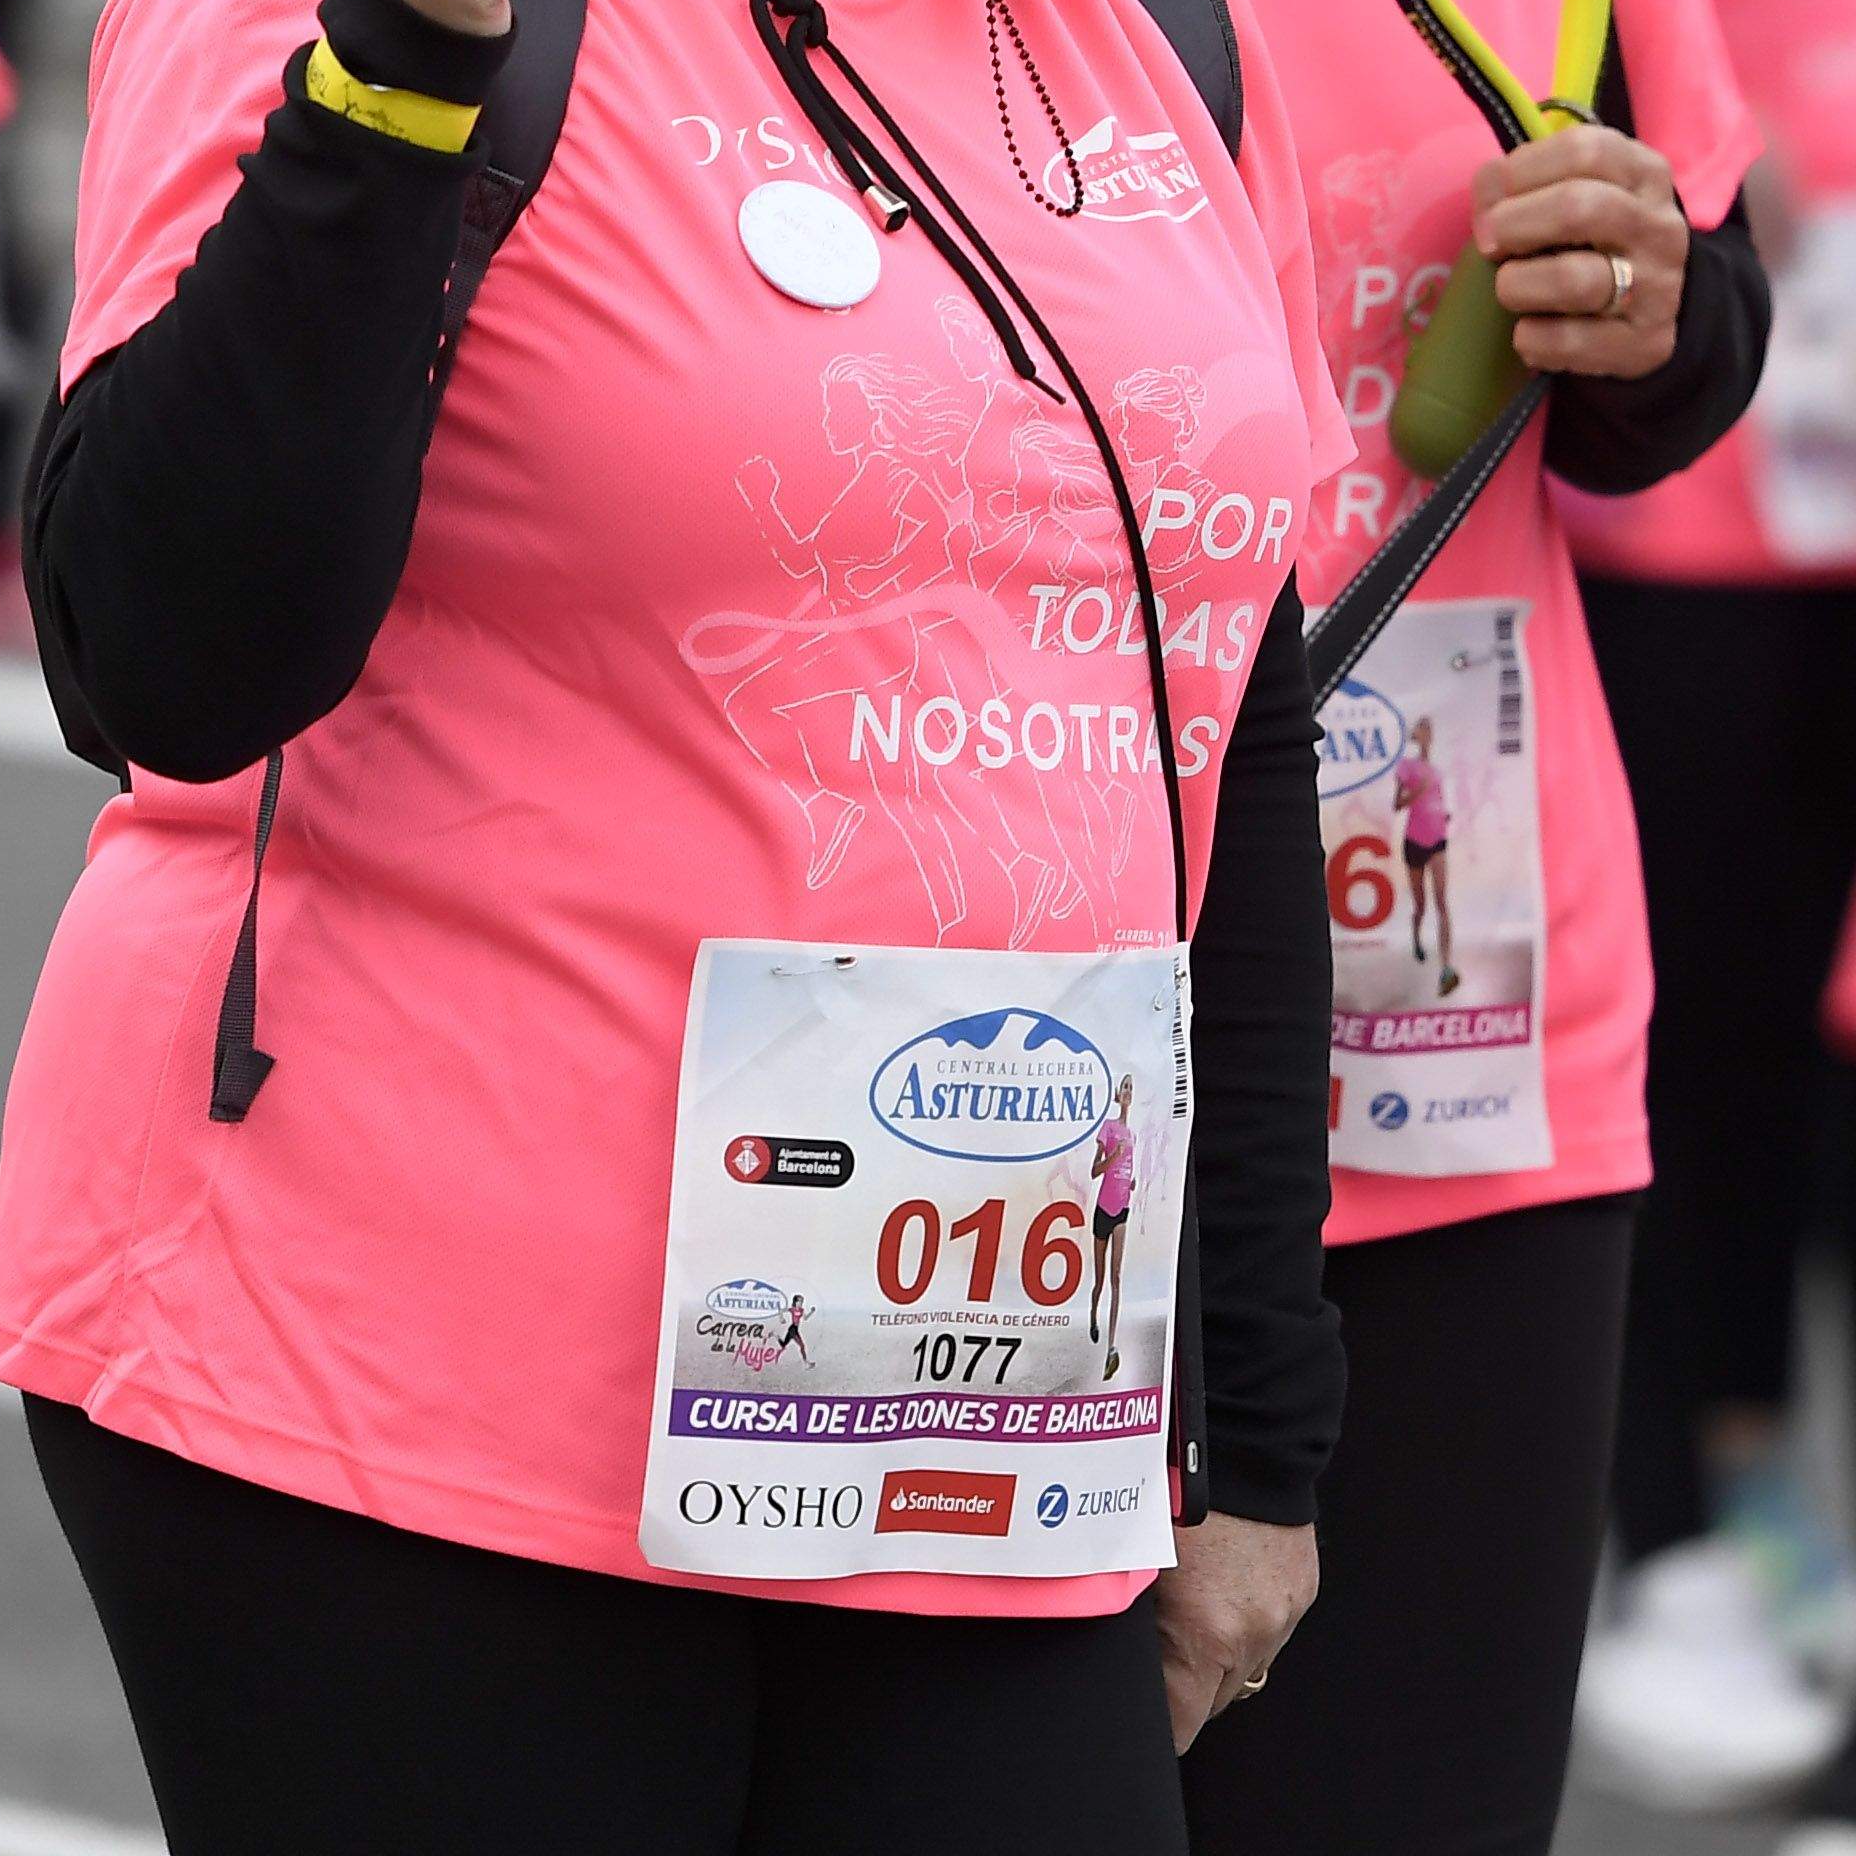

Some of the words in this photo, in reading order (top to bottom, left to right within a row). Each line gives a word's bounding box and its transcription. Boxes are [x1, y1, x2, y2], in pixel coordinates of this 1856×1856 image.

[1142, 487, 1294, 565] POR
[936, 1059, 1019, 1077] CENTRAL
[1026, 1060, 1095, 1077] LECHERA
[888, 1062, 1096, 1122] ASTURIANA
[777, 1159, 841, 1176] Barcelona
[876, 1197, 1088, 1307] 016
[696, 1314, 764, 1339] Carrera
[871, 1311, 929, 1327] TELÉFONO
[929, 1311, 999, 1324] VIOLENCIA
[1002, 1313, 1019, 1327] DE
[1021, 1312, 1071, 1328] GÉNERO
[732, 1338, 783, 1372] Mujer
[912, 1333, 1023, 1386] 1077
[688, 1396, 798, 1435] CURSA
[805, 1402, 851, 1435] DE
[852, 1401, 902, 1435] LES
[900, 1398, 1000, 1433] DONES
[1001, 1403, 1045, 1435] DE
[1044, 1394, 1158, 1435] BARCELONA
[678, 1479, 863, 1530] OYSHO
[907, 1489, 996, 1516] Santander
[1076, 1486, 1140, 1518] ZURICH
